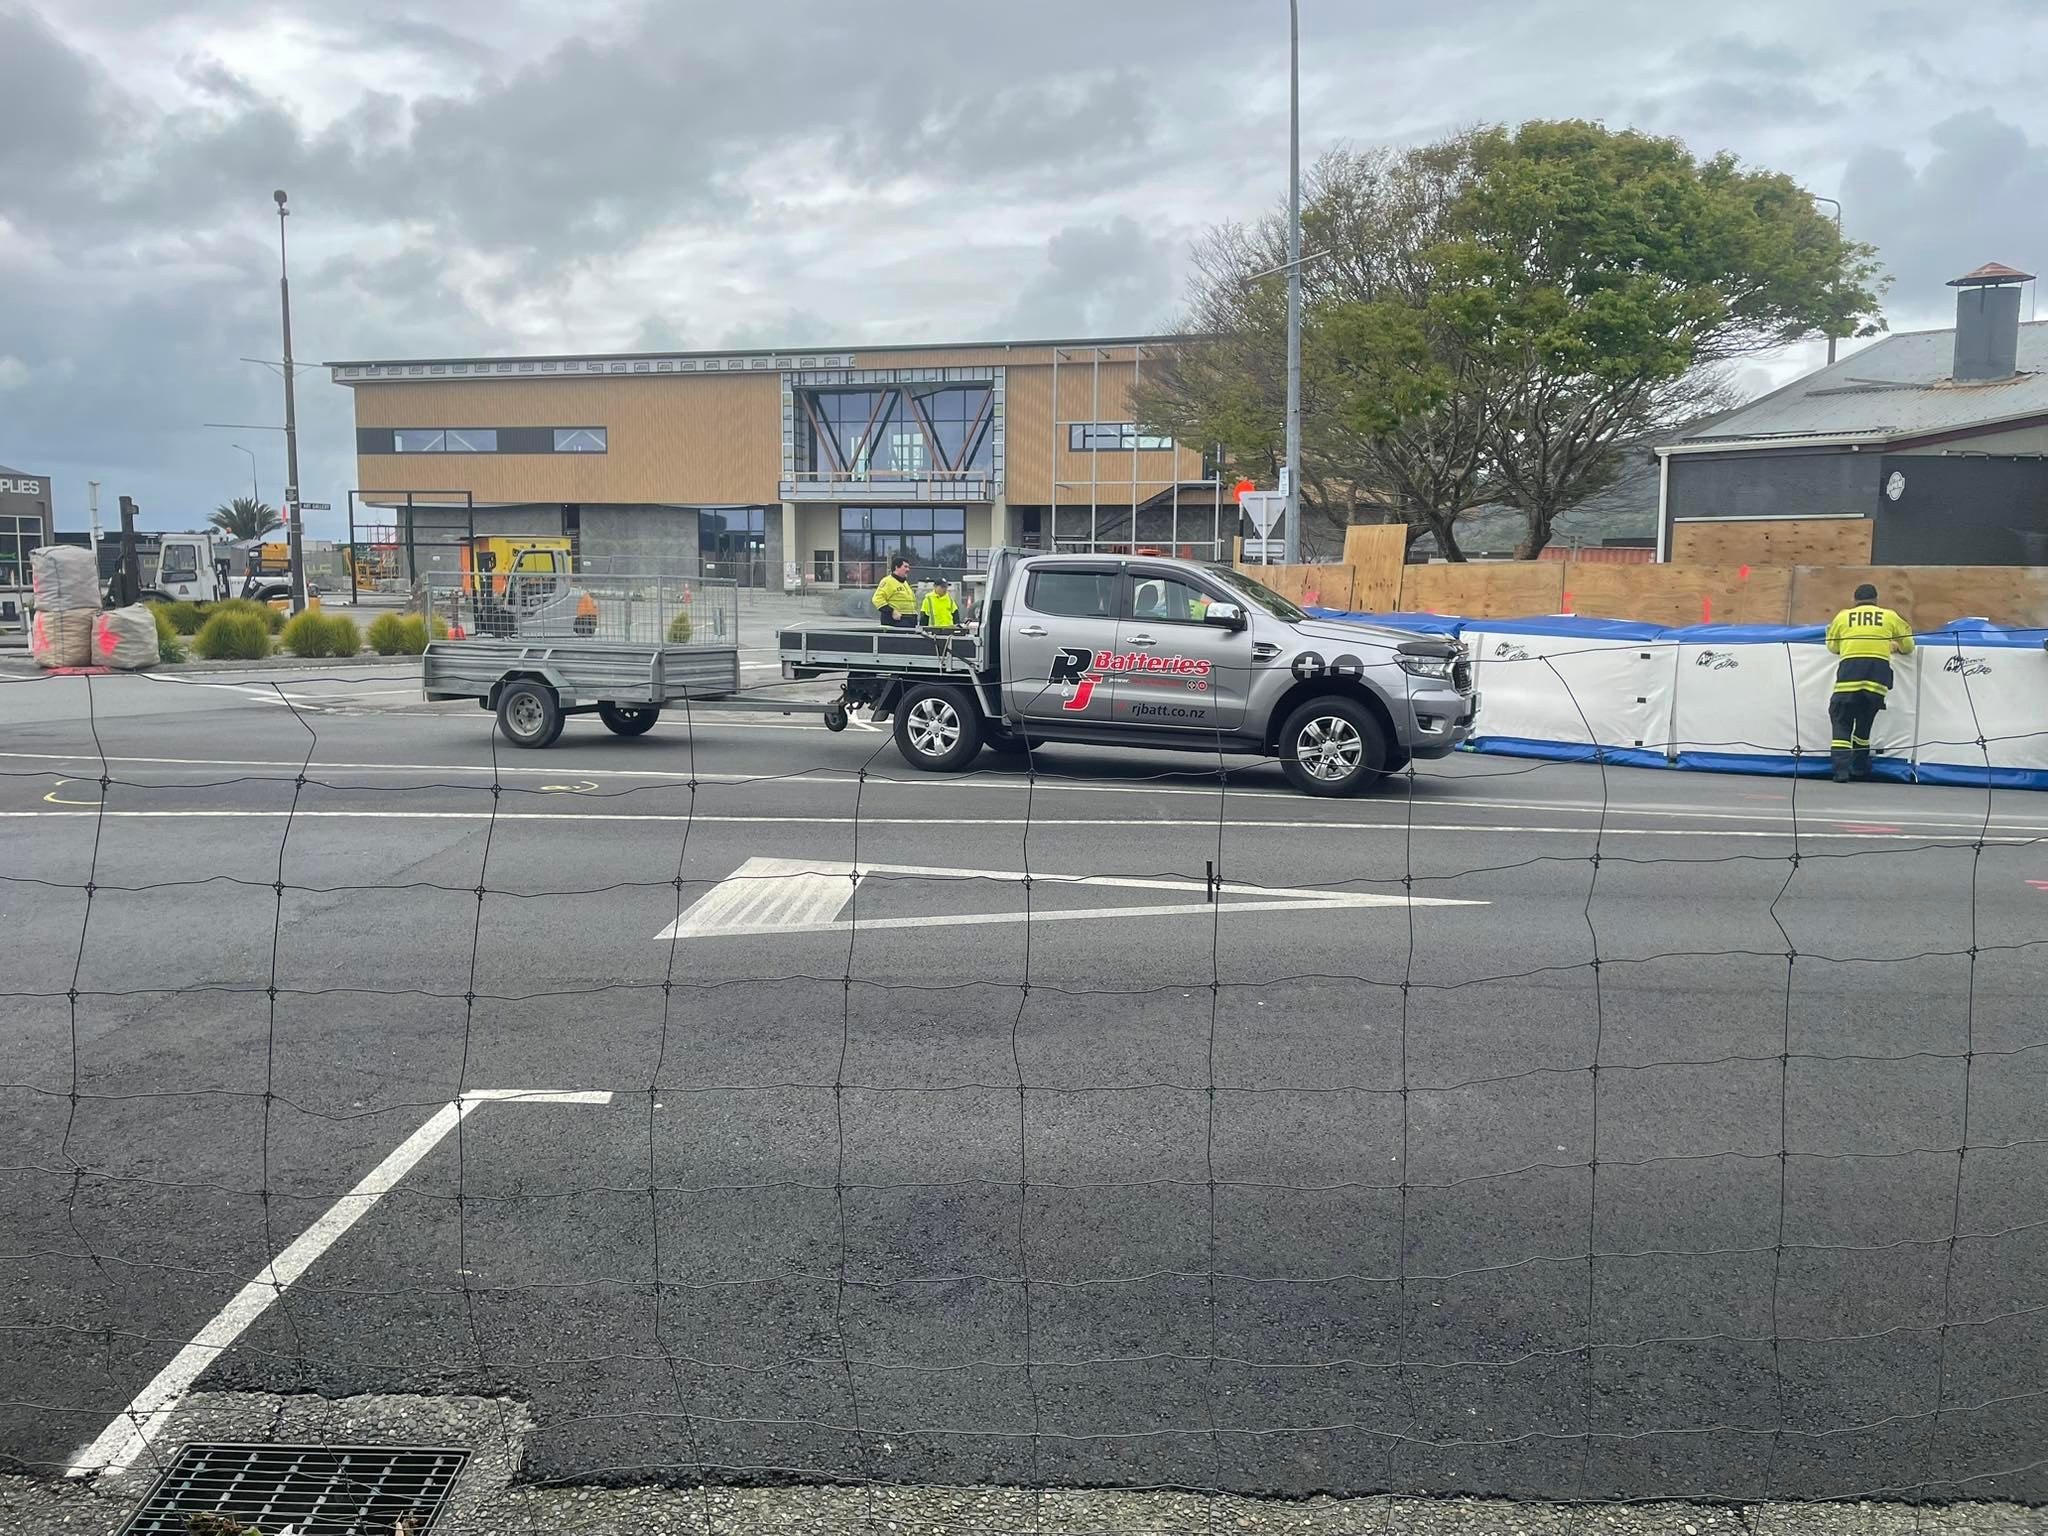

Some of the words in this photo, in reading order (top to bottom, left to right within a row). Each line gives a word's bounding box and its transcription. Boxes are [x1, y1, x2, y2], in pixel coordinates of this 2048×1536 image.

[0, 479, 40, 494] PLIES
[1849, 611, 1883, 627] FIRE
[1094, 650, 1212, 675] Batteries
[1131, 703, 1205, 719] rjbatt.co.nz
